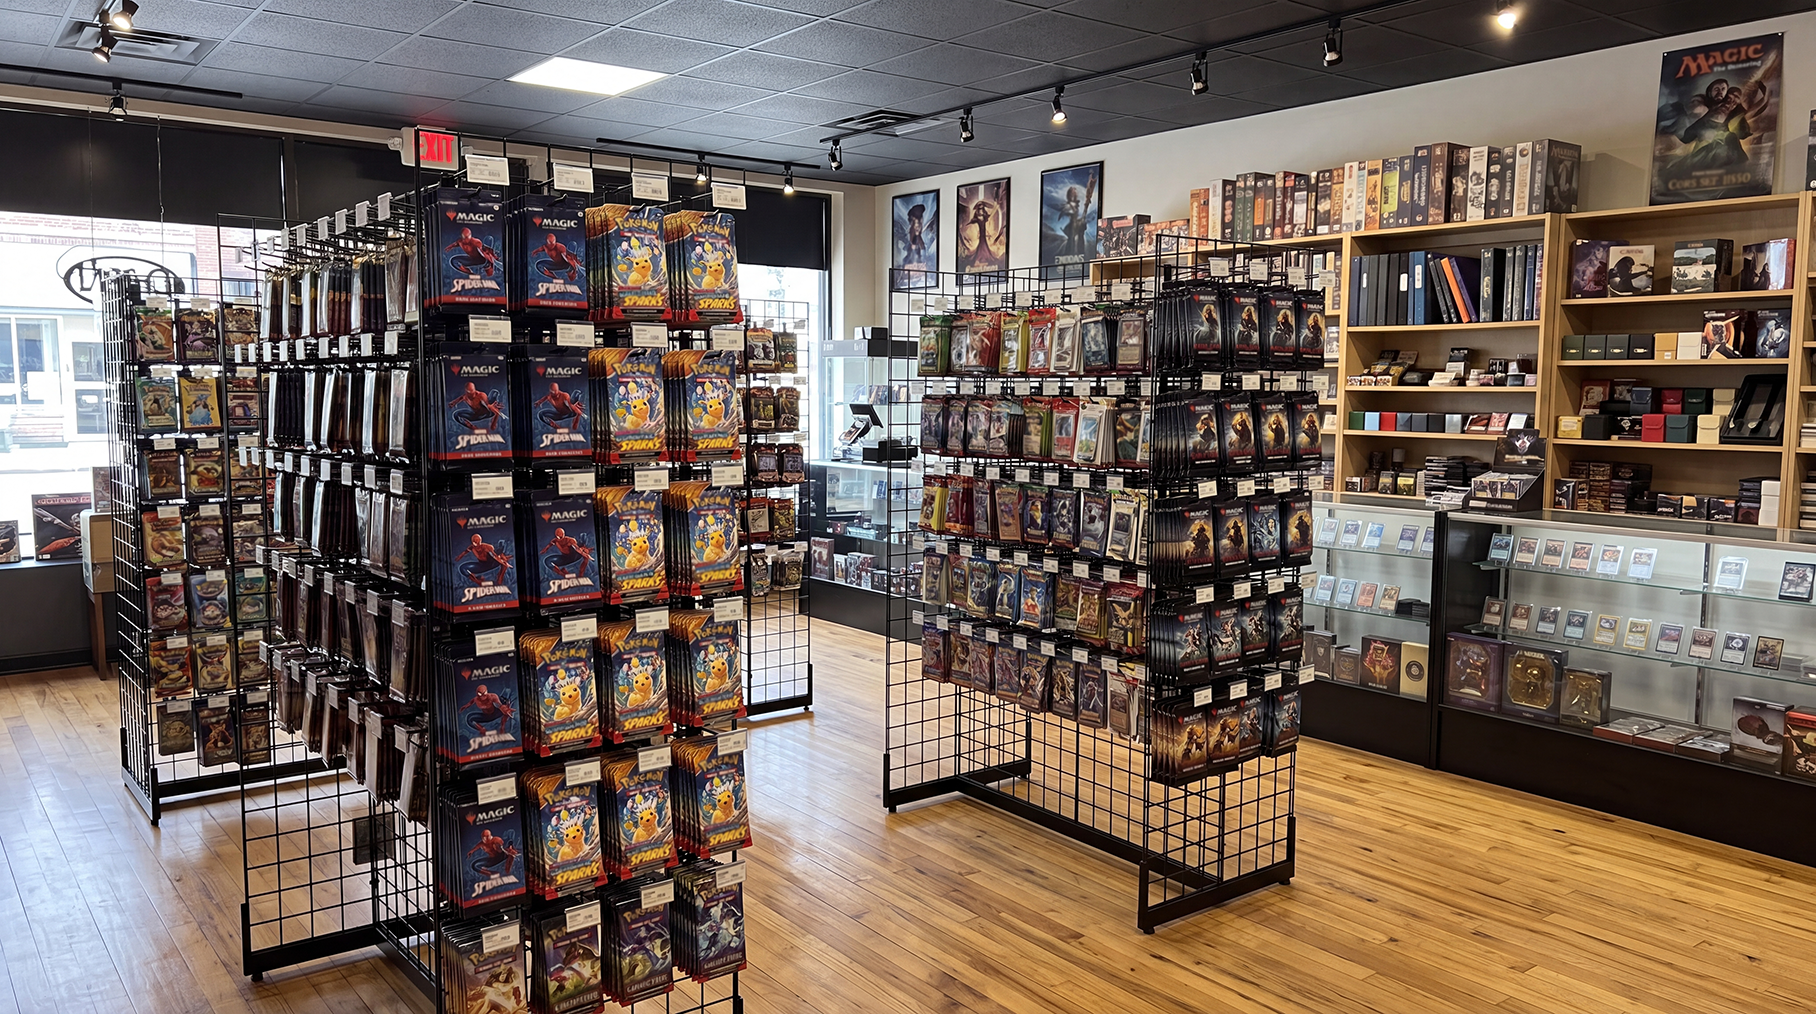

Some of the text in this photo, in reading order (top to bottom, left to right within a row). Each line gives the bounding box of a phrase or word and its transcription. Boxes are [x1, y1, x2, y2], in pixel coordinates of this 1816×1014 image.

[1675, 44, 1765, 79] MAGIC
[418, 132, 454, 164] EXIT
[456, 212, 494, 222] MAGIC
[542, 218, 578, 228] MAGIC
[461, 365, 500, 374] MAGIC
[546, 367, 582, 375] MAGIC
[551, 510, 588, 520] MAGIC
[467, 515, 506, 526] MAGIC
[472, 664, 510, 678] MAGIC
[476, 806, 515, 822] MAGIC
